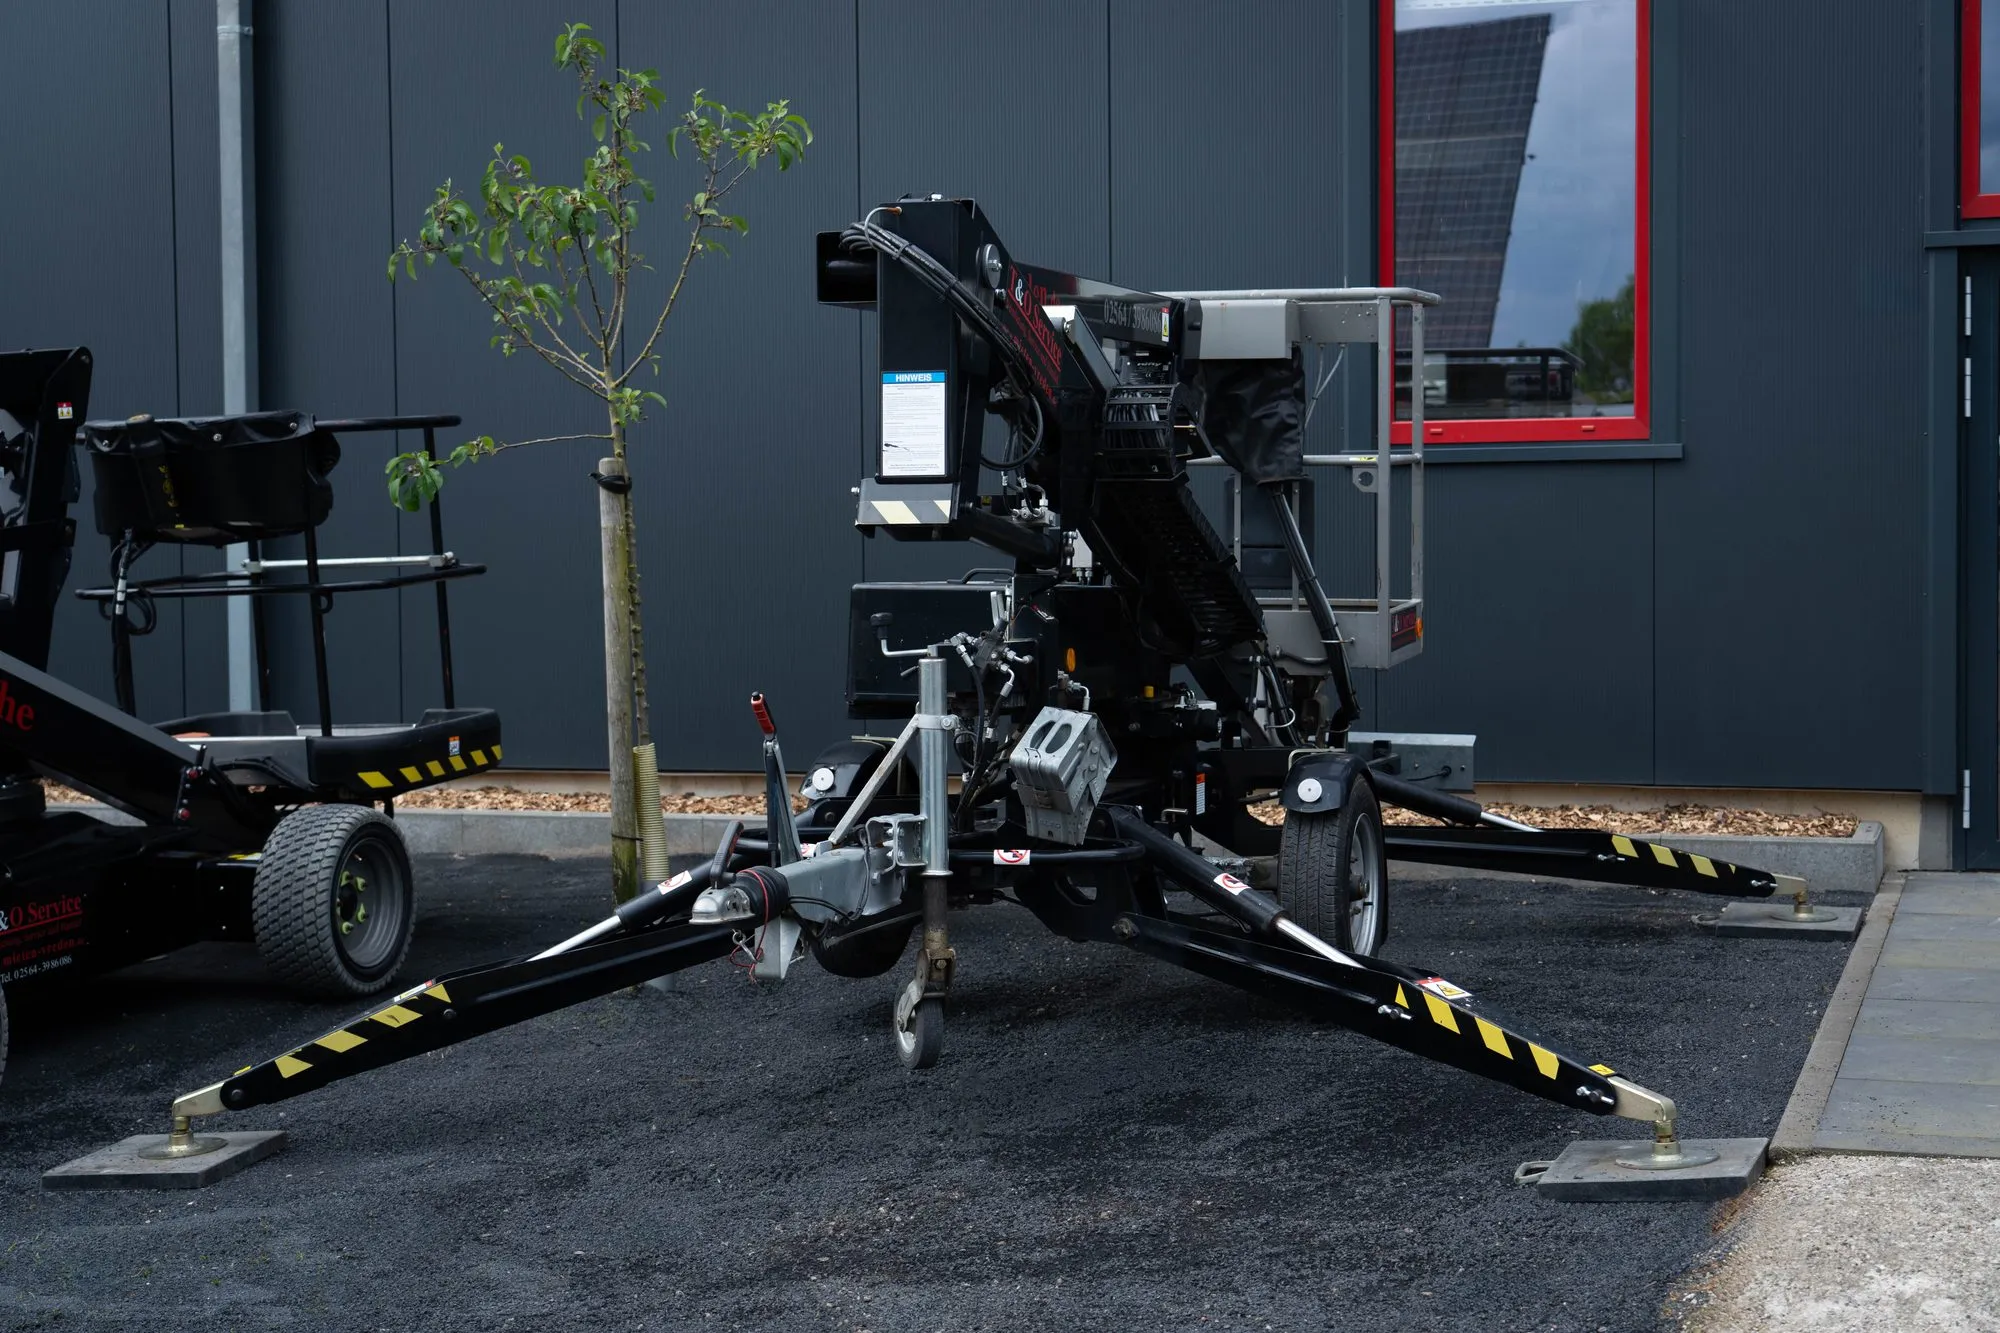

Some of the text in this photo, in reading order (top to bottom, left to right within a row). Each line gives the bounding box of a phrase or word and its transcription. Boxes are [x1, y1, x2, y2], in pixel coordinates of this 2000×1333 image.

[1033, 304, 1062, 368] Service
[895, 373, 932, 382] HINWEIS
[28, 894, 82, 922] Service
